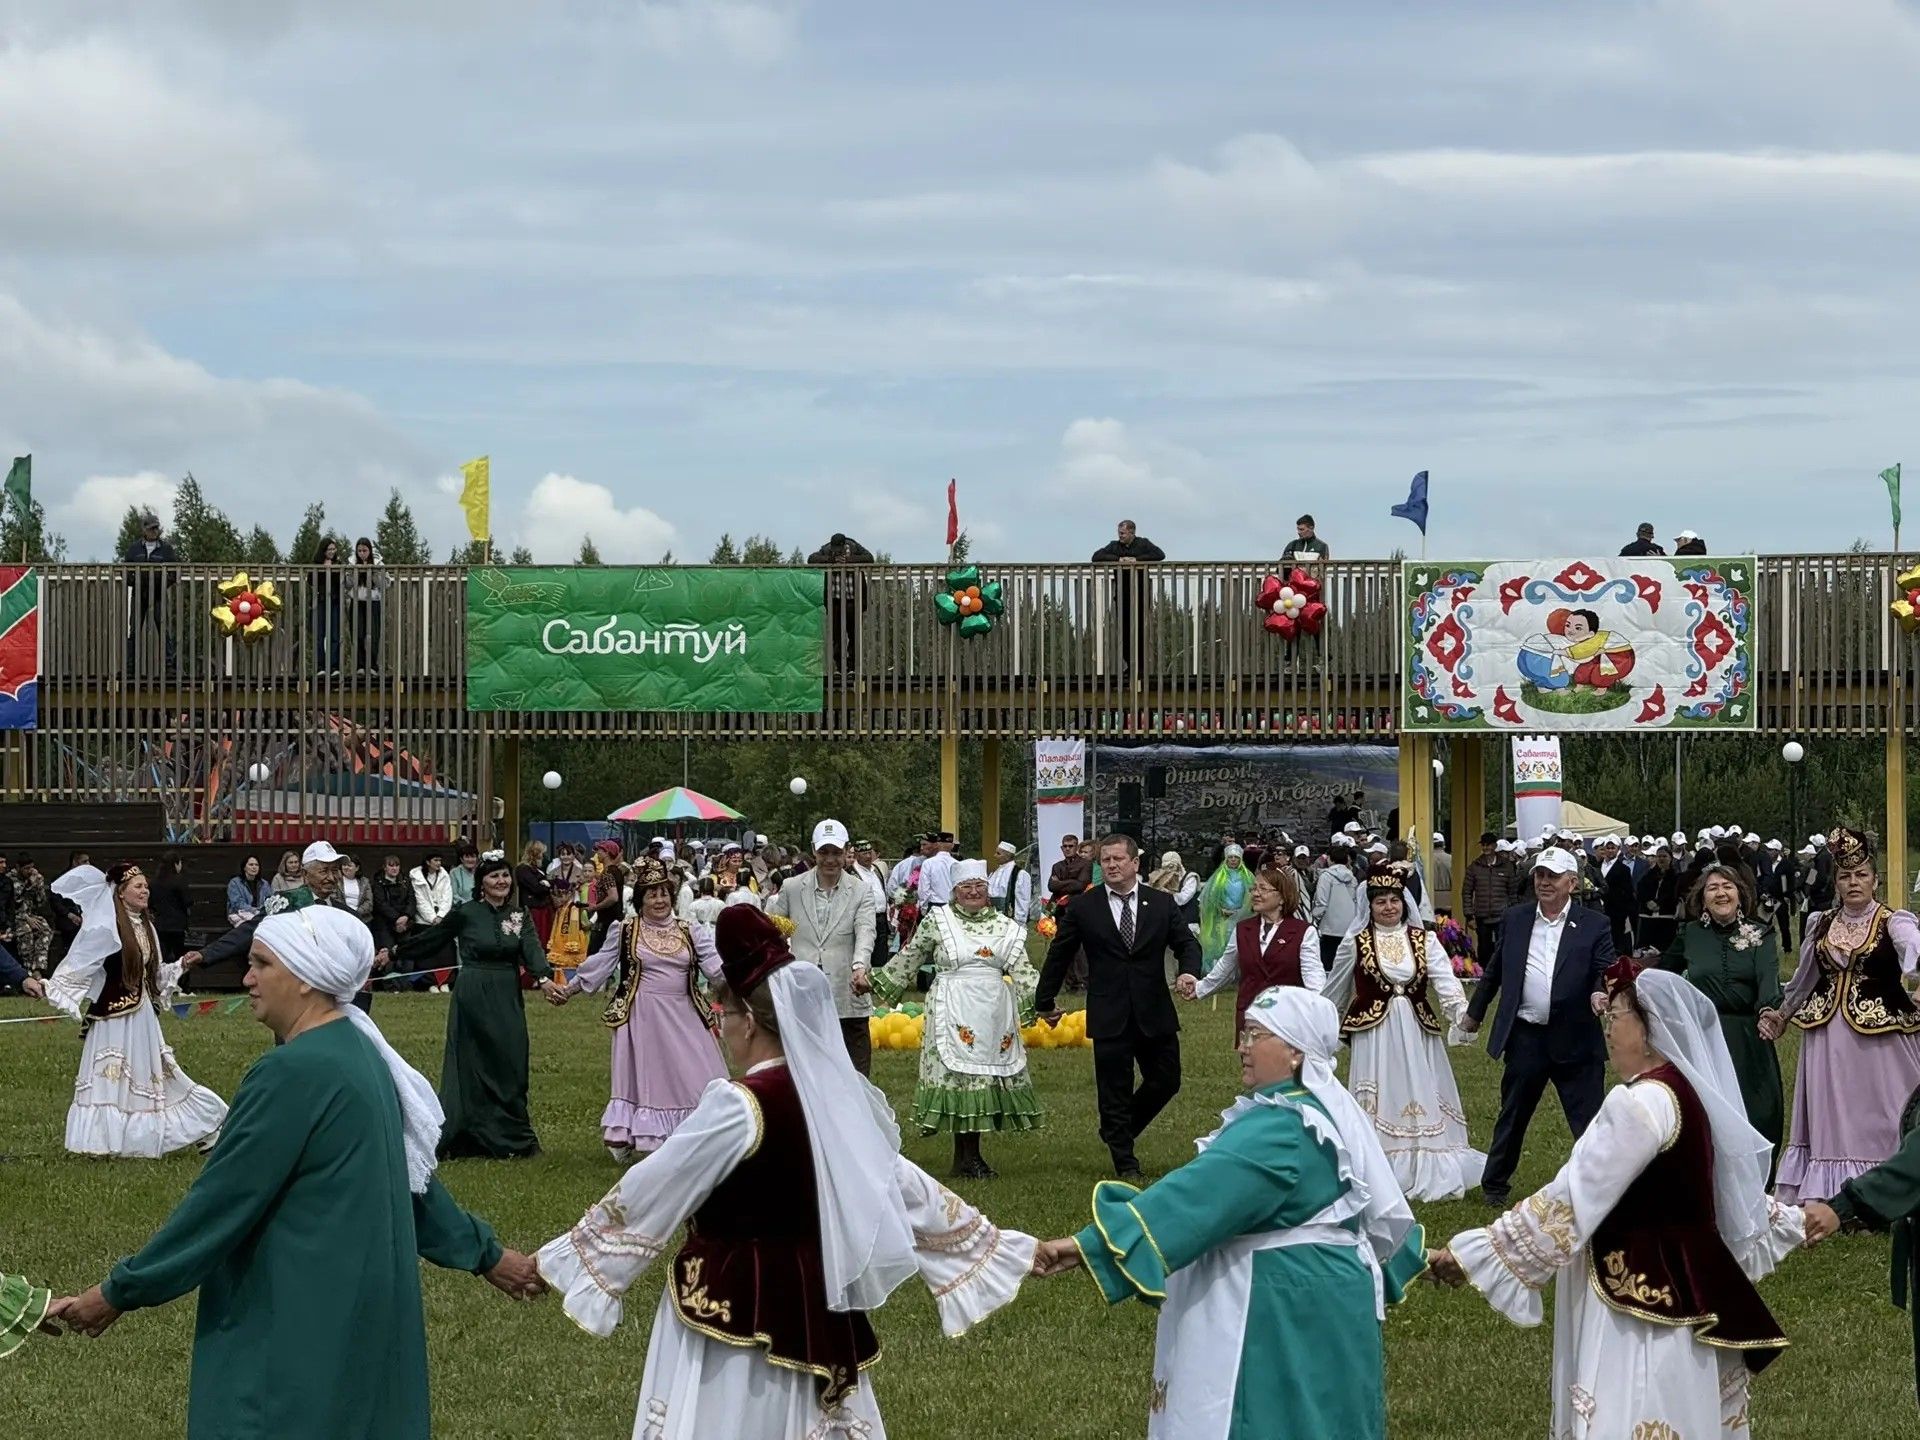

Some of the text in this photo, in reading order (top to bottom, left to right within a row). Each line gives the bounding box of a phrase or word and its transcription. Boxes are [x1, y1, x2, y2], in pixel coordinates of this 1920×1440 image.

[542, 615, 746, 663] Сабантуй
[1039, 753, 1082, 764] Мамадыш
[1516, 749, 1558, 759] Сабантуй
[1091, 772, 1107, 791] С
[1199, 776, 1363, 809] Бәйрәм белән!
